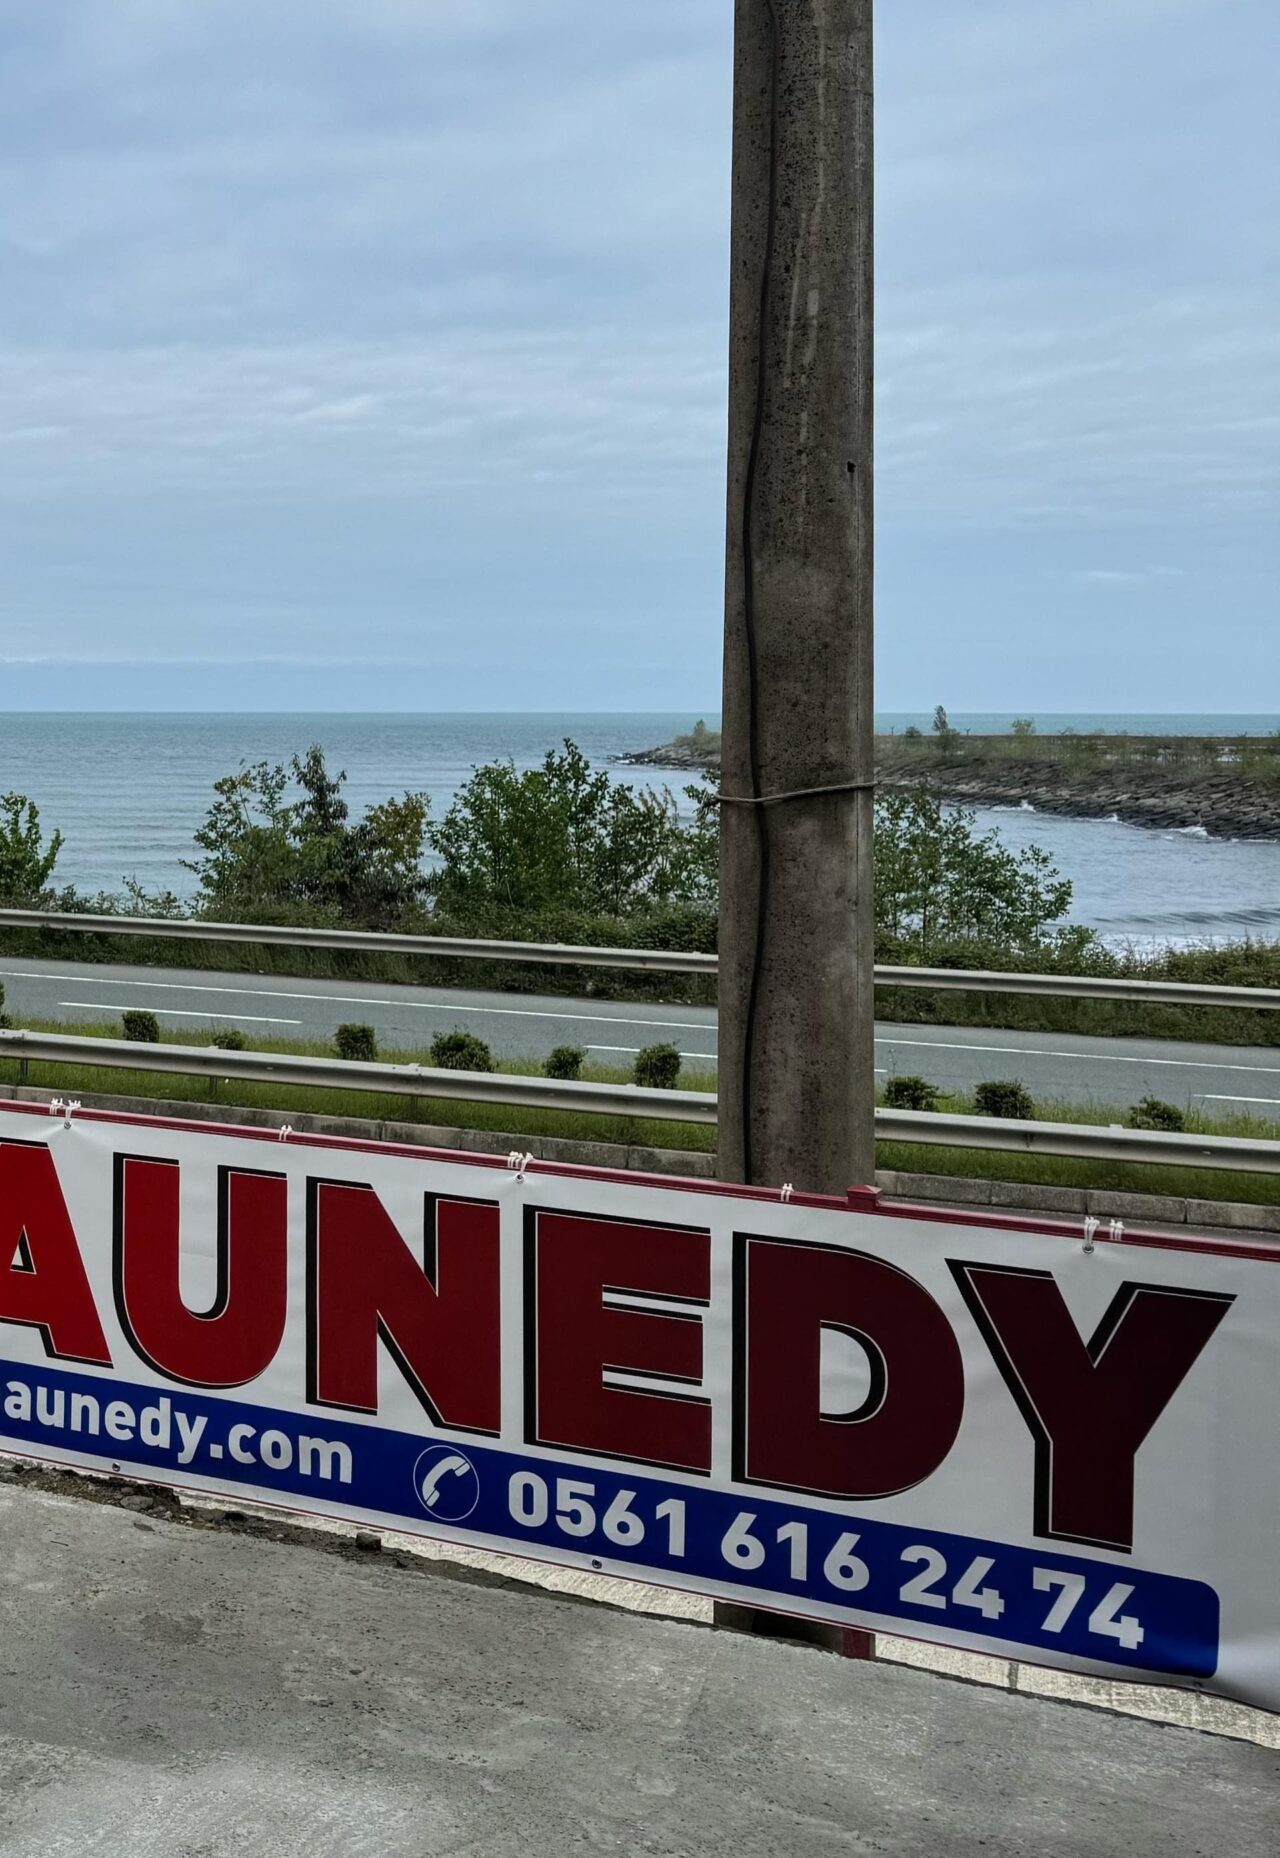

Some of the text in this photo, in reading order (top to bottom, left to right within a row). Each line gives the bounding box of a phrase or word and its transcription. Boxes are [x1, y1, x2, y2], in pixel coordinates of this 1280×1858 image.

[508, 1470, 1146, 1650] 0561 616 24 74
